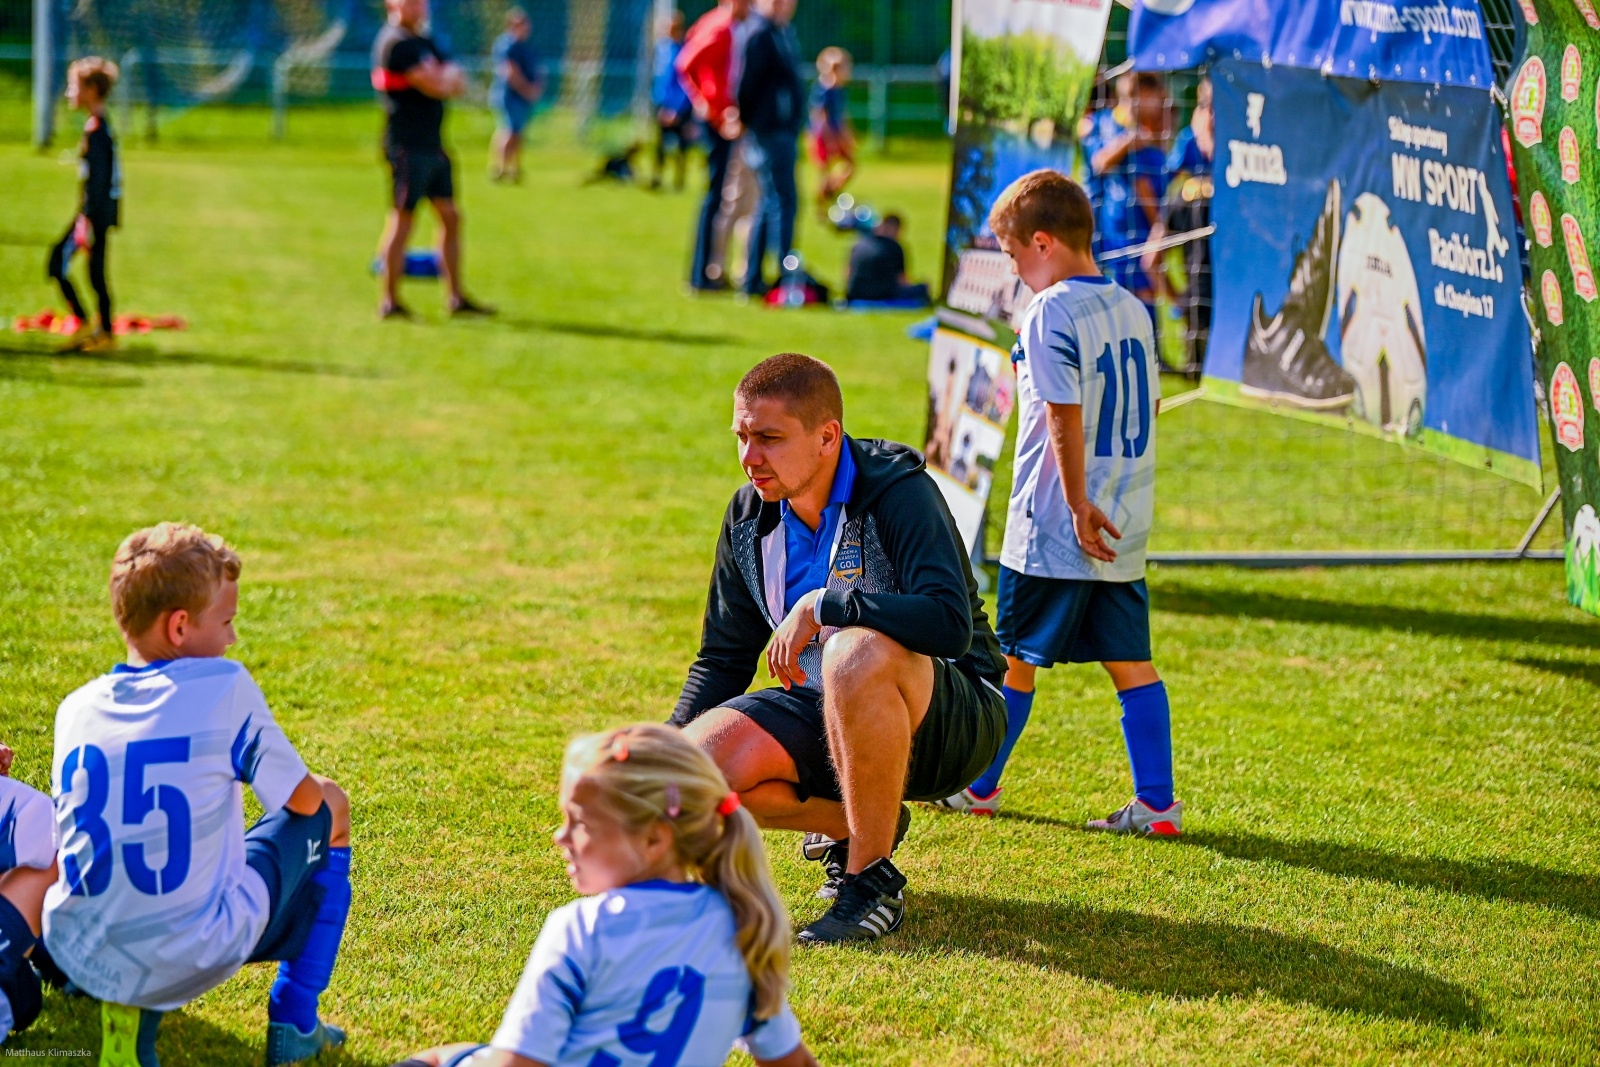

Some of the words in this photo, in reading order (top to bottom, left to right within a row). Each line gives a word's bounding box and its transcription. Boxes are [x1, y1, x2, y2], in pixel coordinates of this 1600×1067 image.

[1423, 159, 1478, 215] SPORT
[1094, 337, 1150, 459] 10
[840, 560, 857, 569] GOL
[586, 964, 706, 1067] 9
